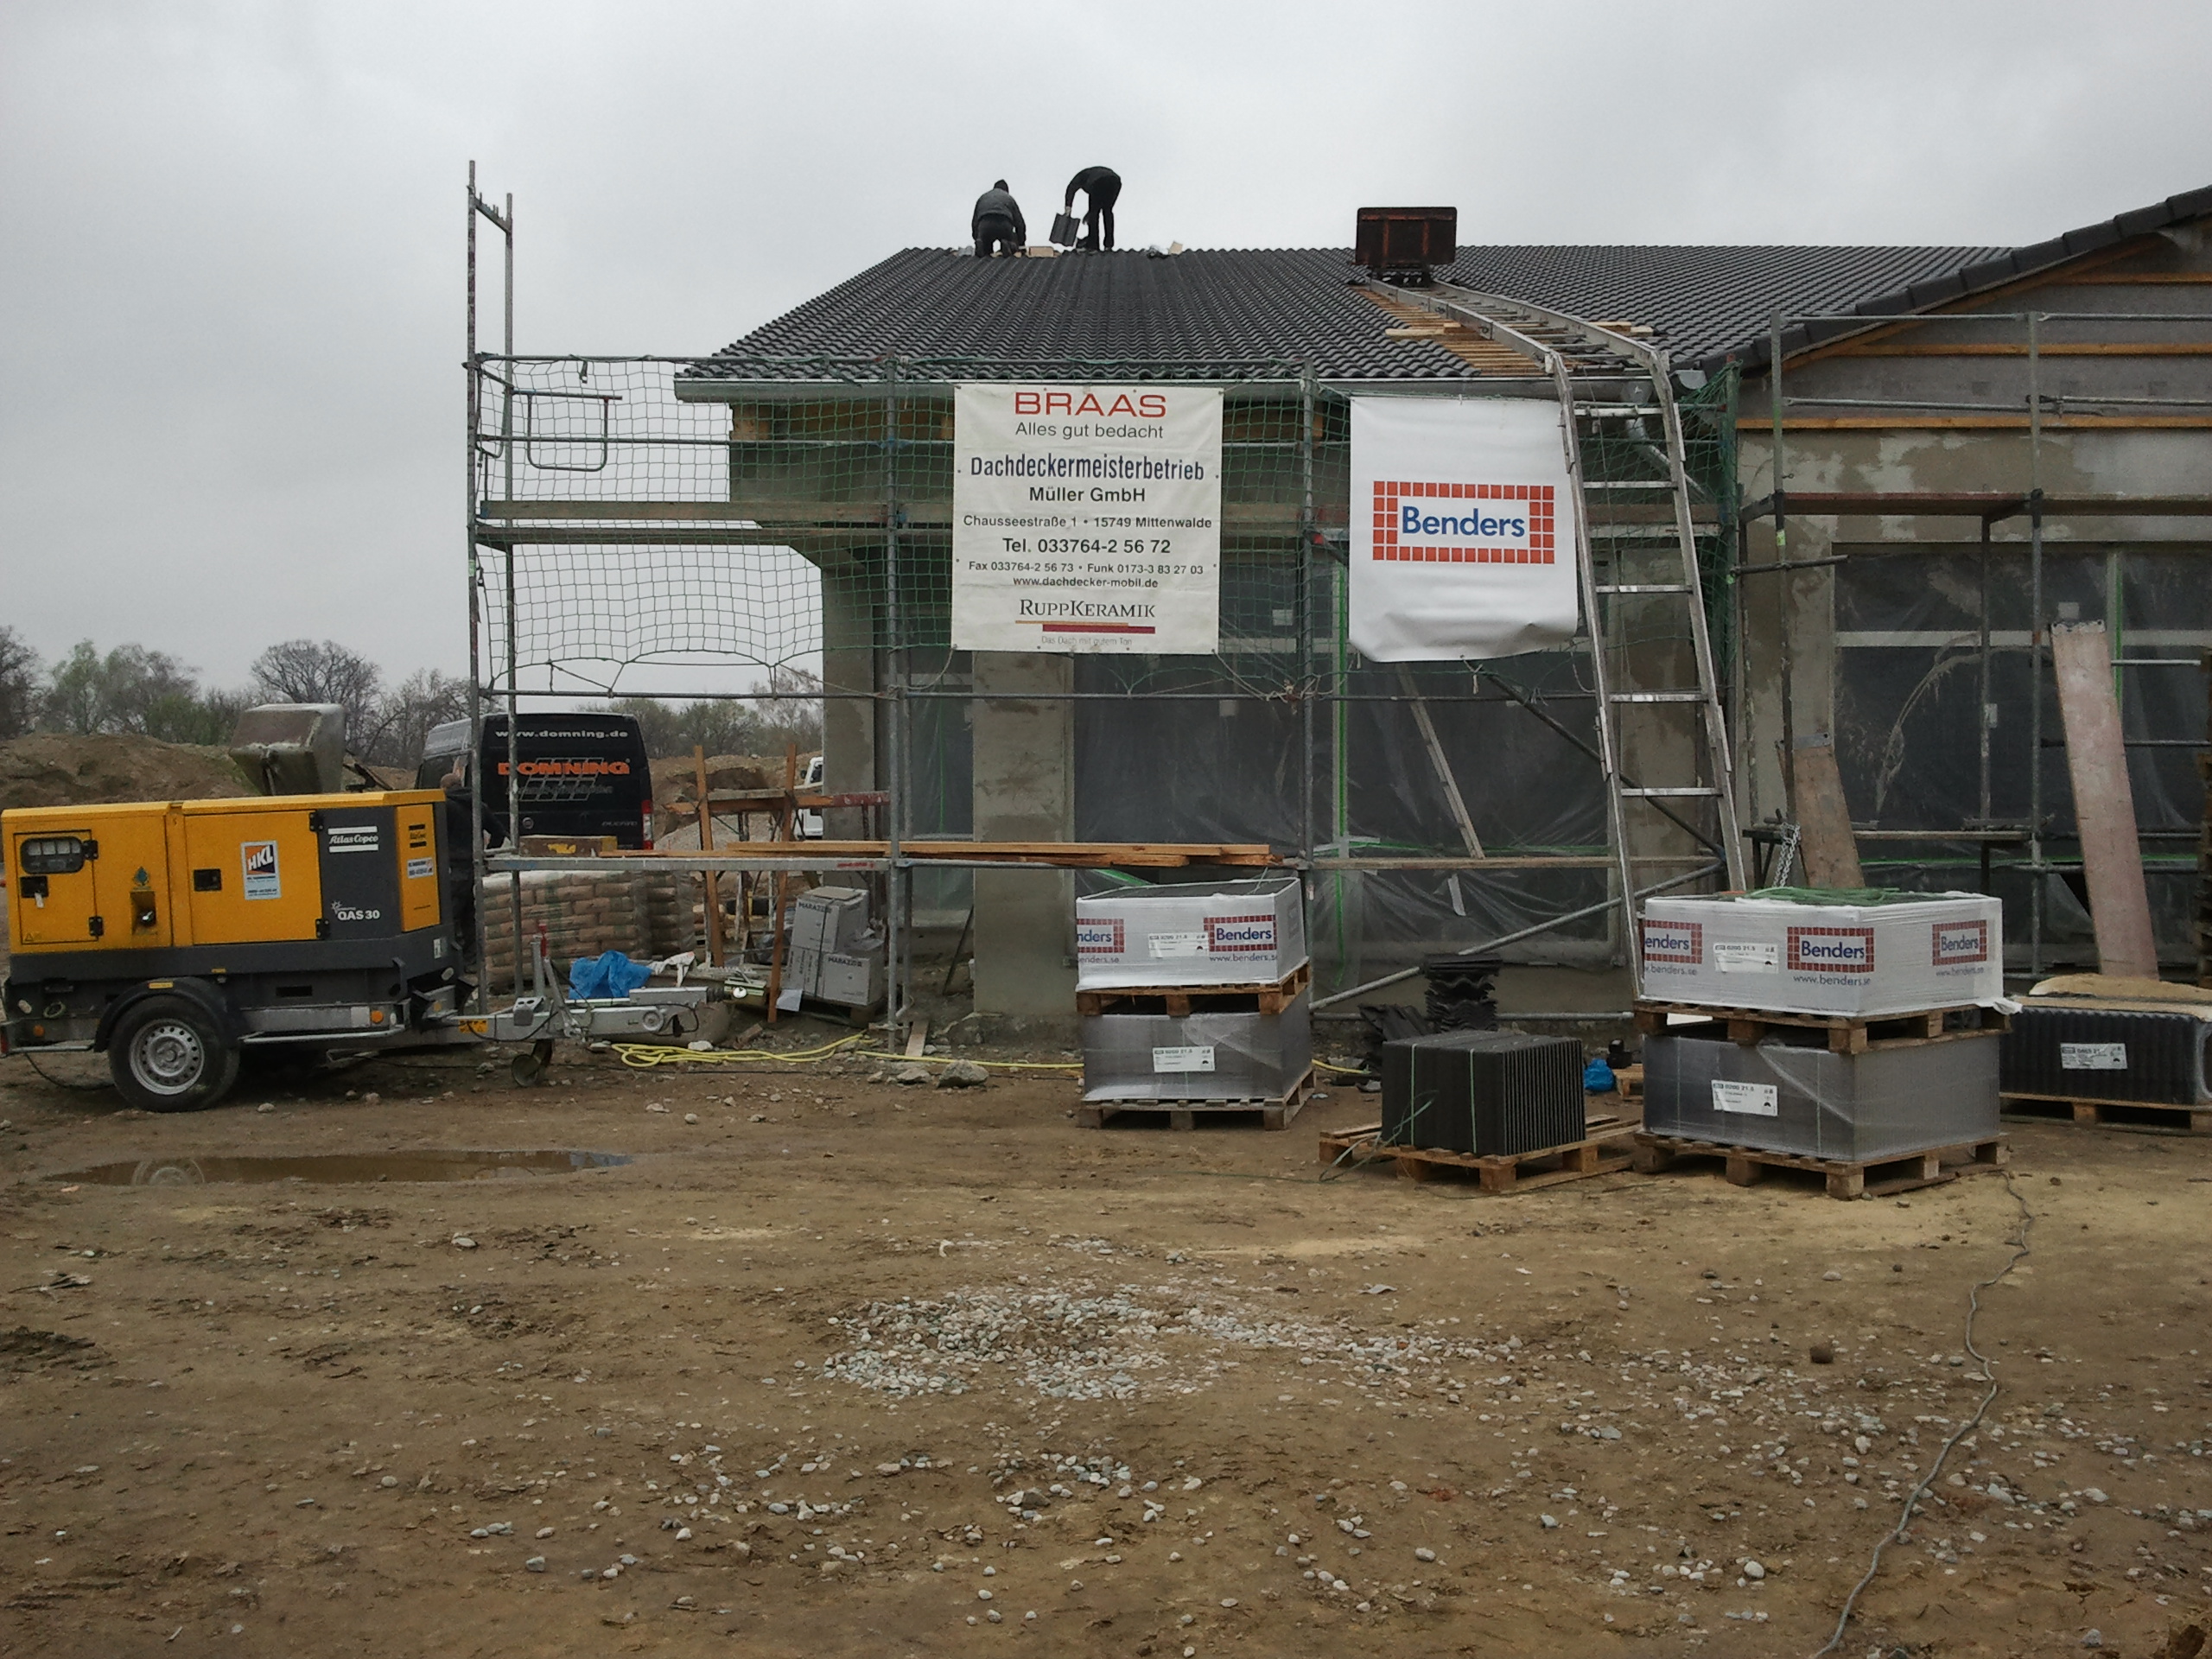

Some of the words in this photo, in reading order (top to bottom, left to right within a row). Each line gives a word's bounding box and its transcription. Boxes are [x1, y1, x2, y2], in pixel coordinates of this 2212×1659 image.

[1014, 392, 1166, 417] BRAAS
[1015, 422, 1057, 436] Alles
[1063, 423, 1089, 440] gut
[1095, 423, 1163, 439] bedacht
[971, 453, 1205, 480] Dachdeckermeisterbetrieb
[1029, 486, 1084, 502] Müller
[1090, 487, 1146, 502] GmbH
[963, 515, 1066, 528] Chausseestraße
[1071, 517, 1077, 528] 1
[1094, 517, 1132, 528] 15749
[1135, 517, 1212, 529] Mittenwalde
[1402, 505, 1525, 537] Benders
[1002, 537, 1032, 553] Tel.
[1038, 539, 1118, 554] 033764-2
[1123, 539, 1144, 554] 56
[1150, 539, 1172, 554] 72
[969, 561, 988, 571] Fax
[990, 562, 1041, 572] 033764-2
[1044, 563, 1058, 572] 56
[1059, 563, 1074, 573] 73
[1087, 563, 1114, 573] Funk
[1117, 564, 1154, 575] 0173-3
[1157, 564, 1171, 575] 83
[1173, 564, 1187, 575] 27
[1190, 564, 1204, 575] 03
[1013, 576, 1159, 588] www.dachdecker-mobil.de
[1041, 636, 1055, 645] Das
[498, 761, 630, 775] DOMNING
[247, 845, 274, 870] HKL
[365, 910, 380, 919] 30
[1216, 927, 1272, 940] Benders
[1802, 941, 1865, 958] Benders
[1941, 934, 1979, 950] Benders
